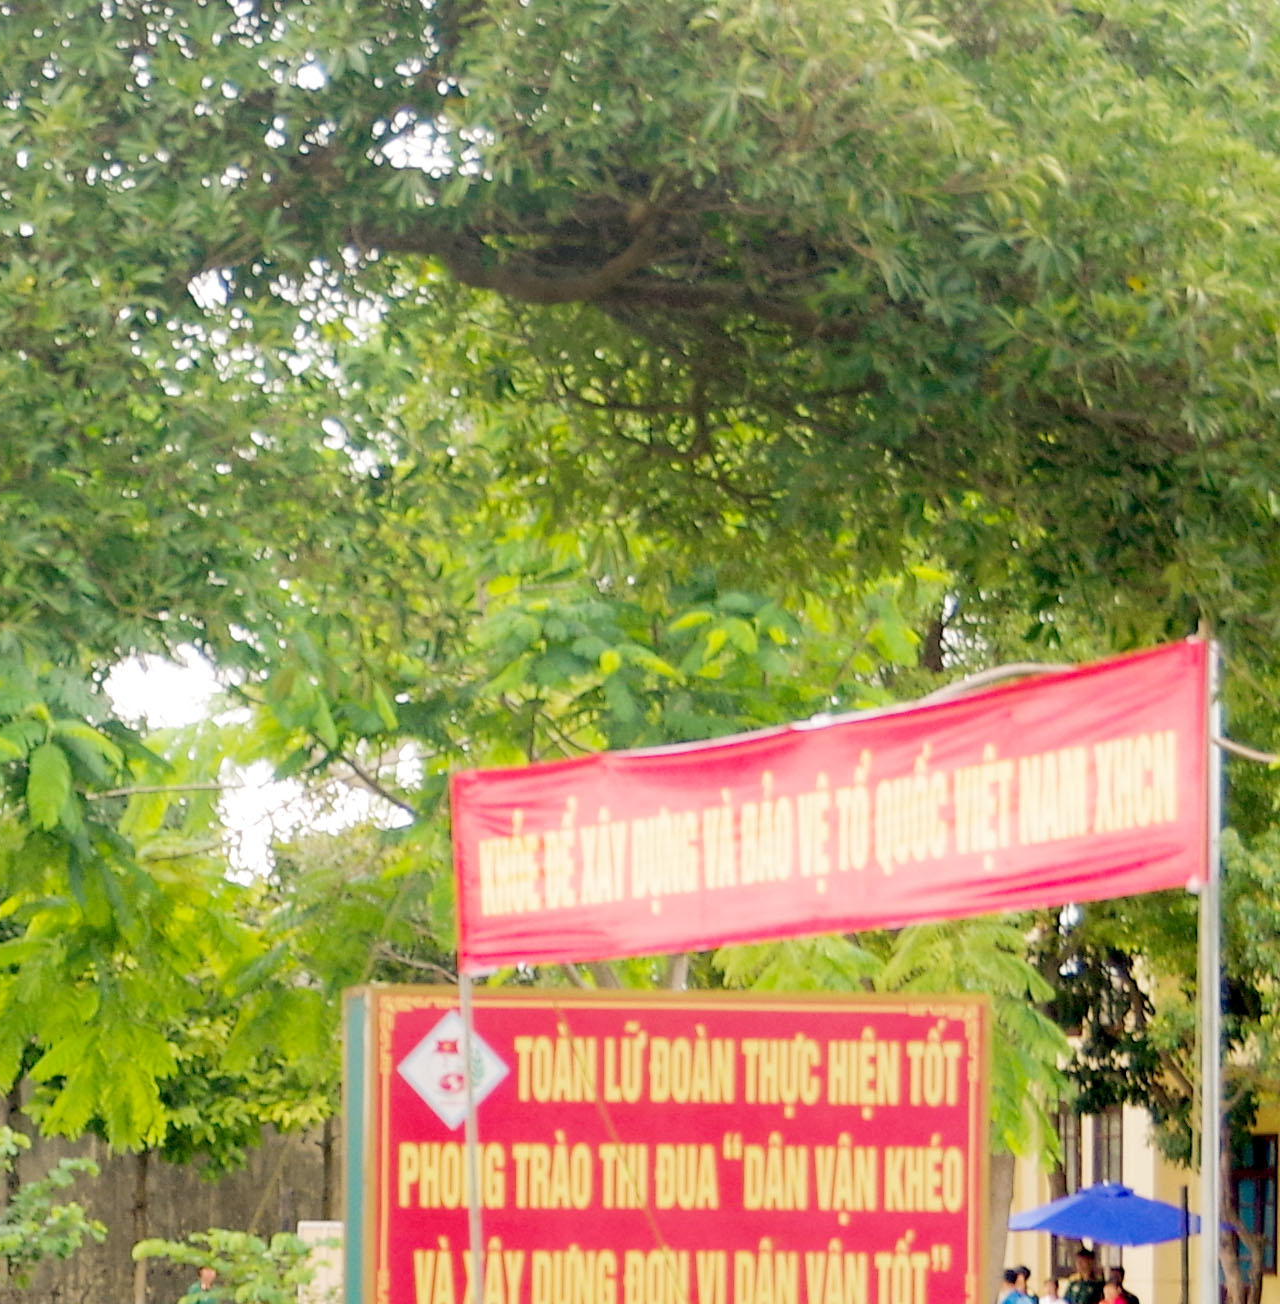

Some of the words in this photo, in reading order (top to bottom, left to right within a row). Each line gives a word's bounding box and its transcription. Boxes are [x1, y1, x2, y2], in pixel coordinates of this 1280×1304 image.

[580, 805, 628, 905] XÂY
[631, 806, 699, 916] DỰNG
[702, 787, 737, 890] VÀ
[741, 770, 791, 885] BẢO
[797, 771, 830, 895] VỆ
[835, 749, 870, 871] TỔ
[875, 742, 948, 876] QUỐC
[954, 742, 1015, 872] VIỆT
[1019, 746, 1089, 845] NAM
[1094, 729, 1177, 834] XHCN
[514, 1022, 597, 1102] TOÀN
[604, 1021, 648, 1102] LỮ
[649, 1023, 734, 1103] ĐOÀN
[742, 1033, 821, 1119] THỰC
[828, 1026, 900, 1120] HIỆN
[906, 1018, 962, 1107] TỐT
[398, 1141, 506, 1209] PHONG
[512, 1129, 591, 1210] TRÀO
[599, 1143, 648, 1210] THI
[655, 1143, 719, 1210] ĐUA
[814, 1132, 877, 1226] VẬN
[884, 1132, 963, 1213] KHÉO
